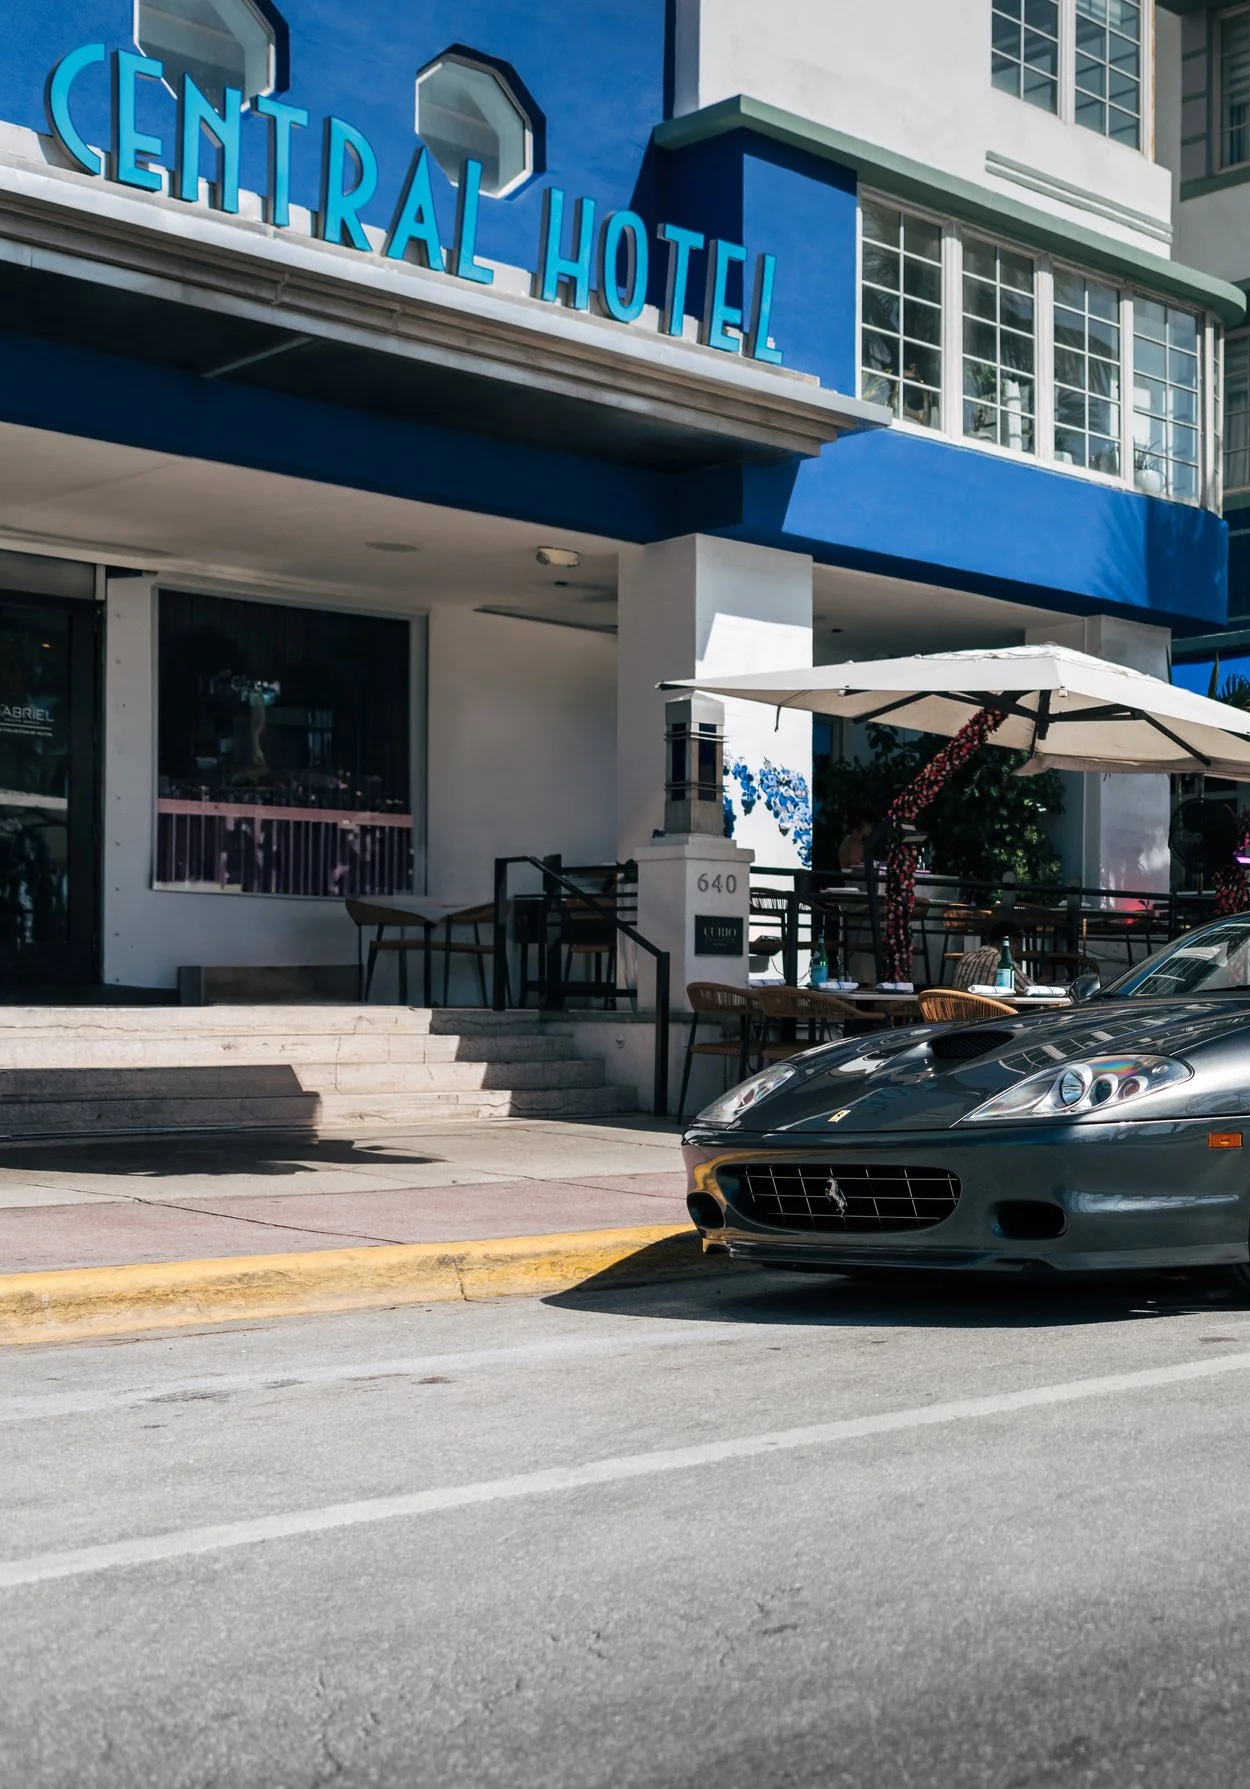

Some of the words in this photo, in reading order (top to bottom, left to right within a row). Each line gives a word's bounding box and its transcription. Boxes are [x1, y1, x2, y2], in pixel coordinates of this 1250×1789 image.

[45, 42, 494, 284] CENTRAL
[537, 187, 784, 364] HOTEL
[697, 873, 737, 893] 640
[703, 927, 737, 937] CURIO
